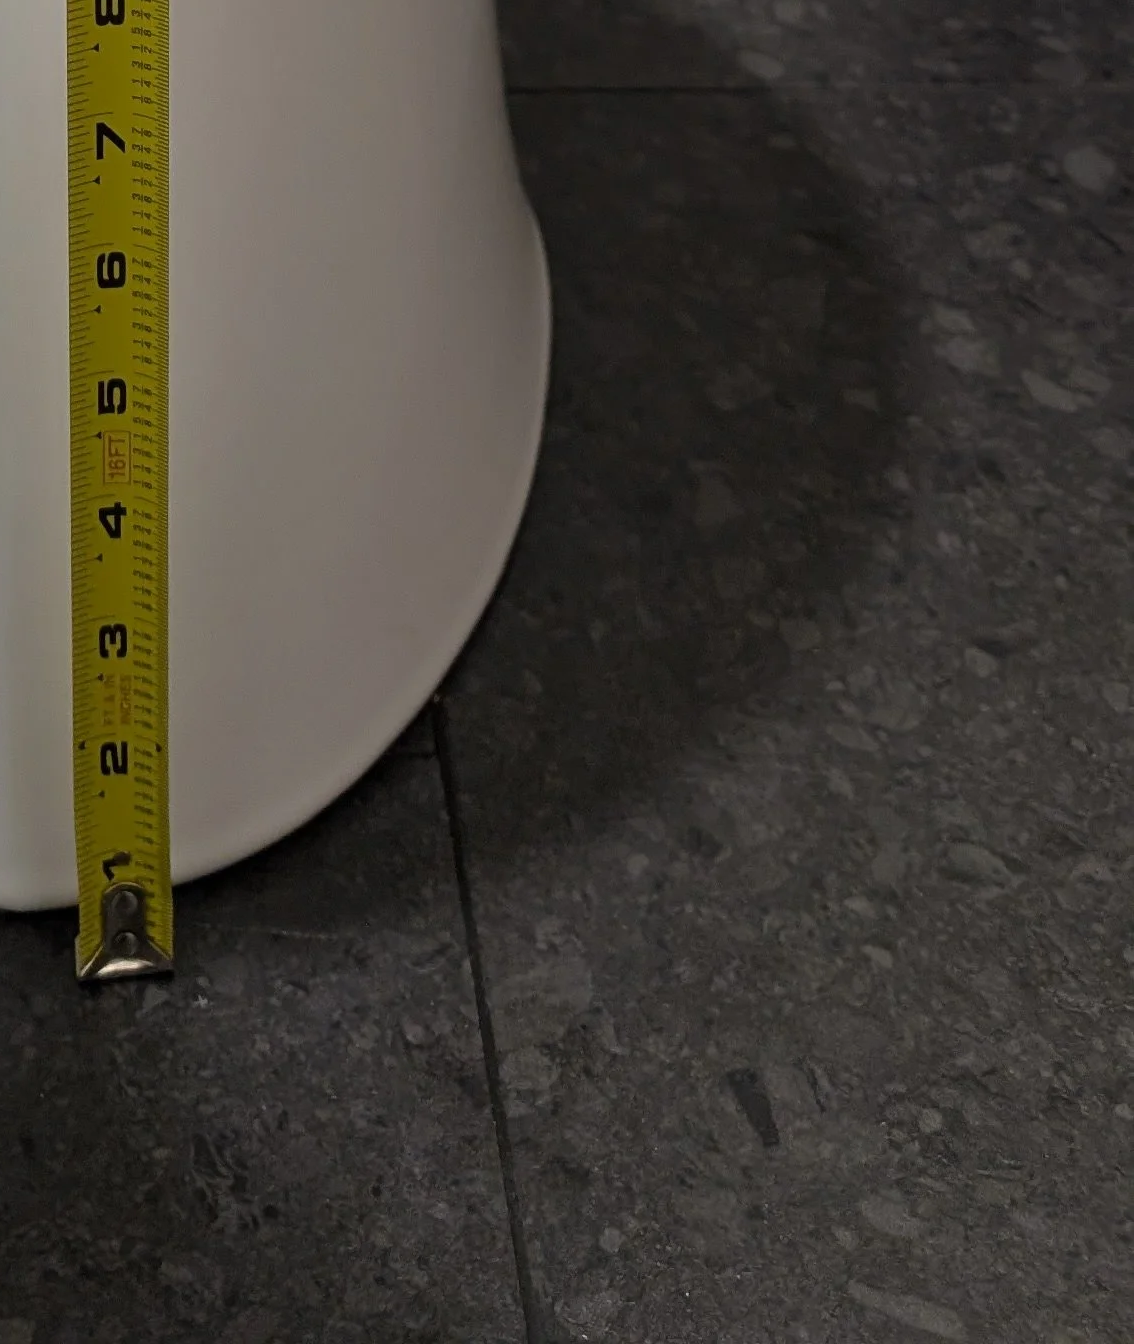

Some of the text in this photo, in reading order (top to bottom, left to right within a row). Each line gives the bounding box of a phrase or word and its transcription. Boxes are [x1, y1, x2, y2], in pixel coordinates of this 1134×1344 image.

[96, 122, 126, 160] 7
[96, 251, 127, 289] 6
[97, 377, 127, 415] 5
[98, 501, 128, 539] 4
[98, 622, 128, 659] 3
[100, 741, 129, 776] 2
[102, 851, 132, 881] 1
